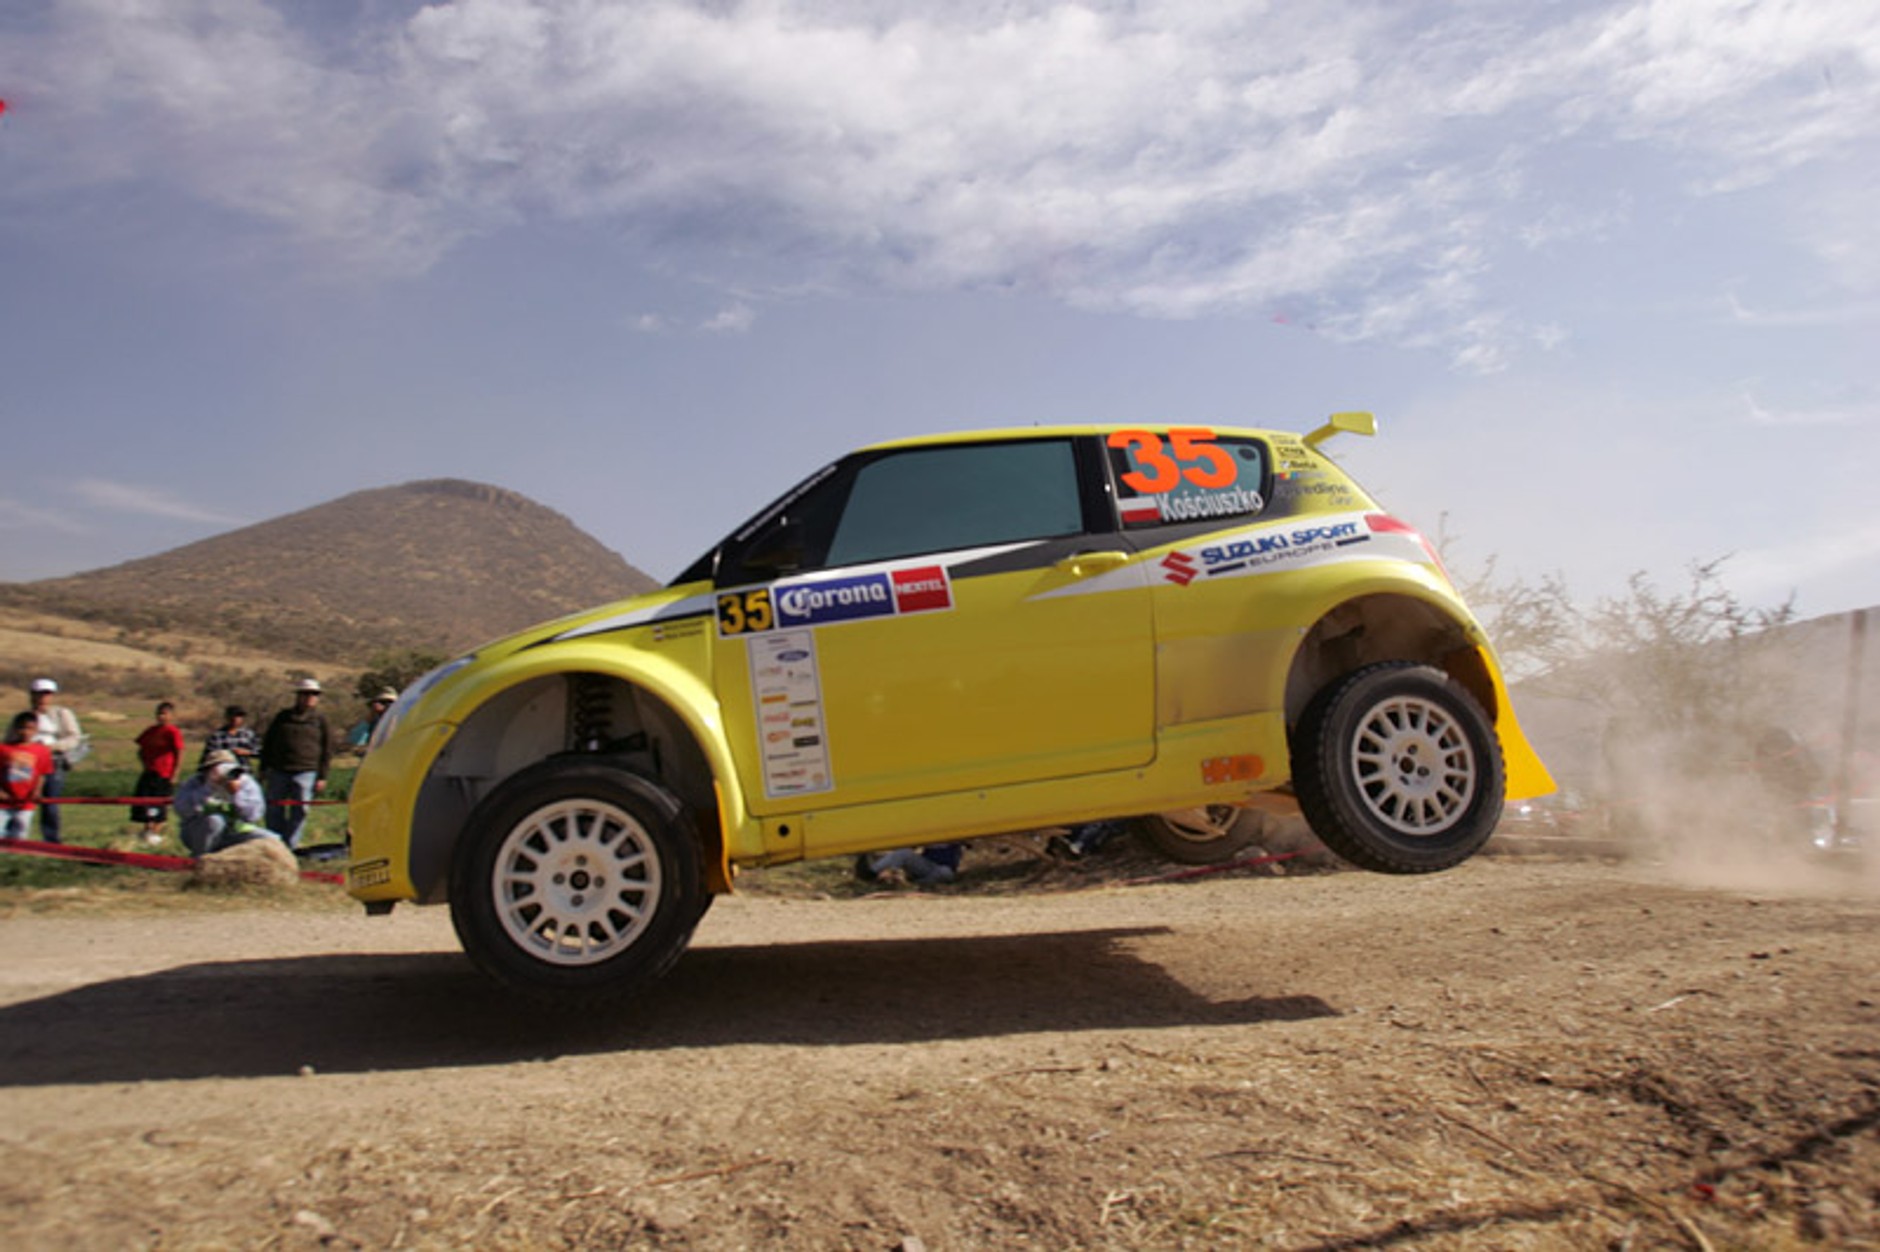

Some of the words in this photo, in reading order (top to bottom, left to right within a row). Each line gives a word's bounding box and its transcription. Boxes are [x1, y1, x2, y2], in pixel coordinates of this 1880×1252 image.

[1107, 428, 1238, 494] 35
[1156, 485, 1264, 521] Kościuszko
[1201, 534, 1289, 565] SUZUKI
[1292, 522, 1357, 546] SPORT
[1250, 542, 1334, 567] EUROPE
[719, 589, 774, 634] 35
[780, 581, 887, 618] Corona
